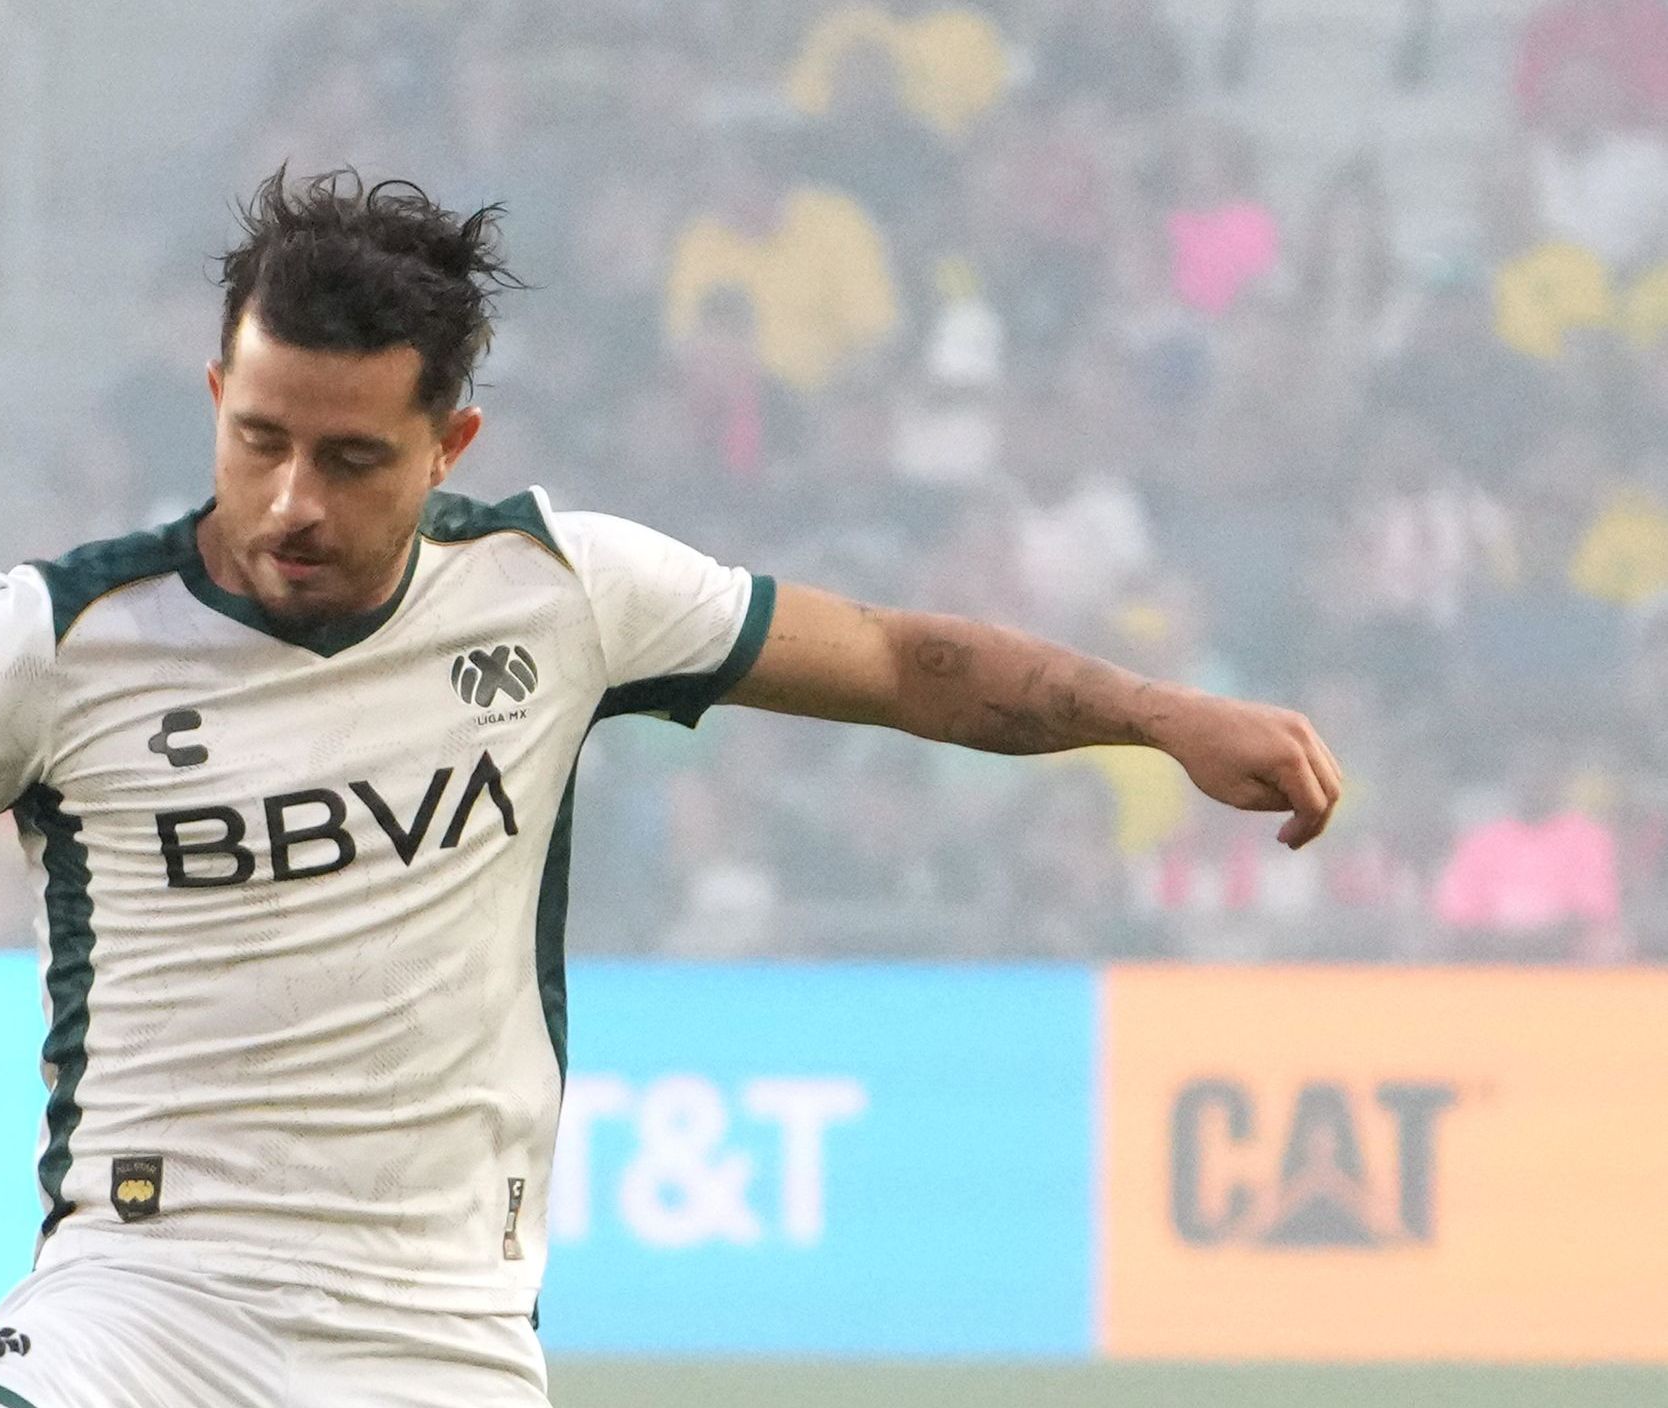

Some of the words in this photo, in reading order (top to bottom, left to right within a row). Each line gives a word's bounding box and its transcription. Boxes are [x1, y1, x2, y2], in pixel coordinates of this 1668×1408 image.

[477, 713, 505, 726] LIGA
[509, 709, 527, 720] MX
[155, 749, 519, 888] BBVA
[550, 1073, 867, 1246] T&T
[1168, 1076, 1460, 1249] CAT
